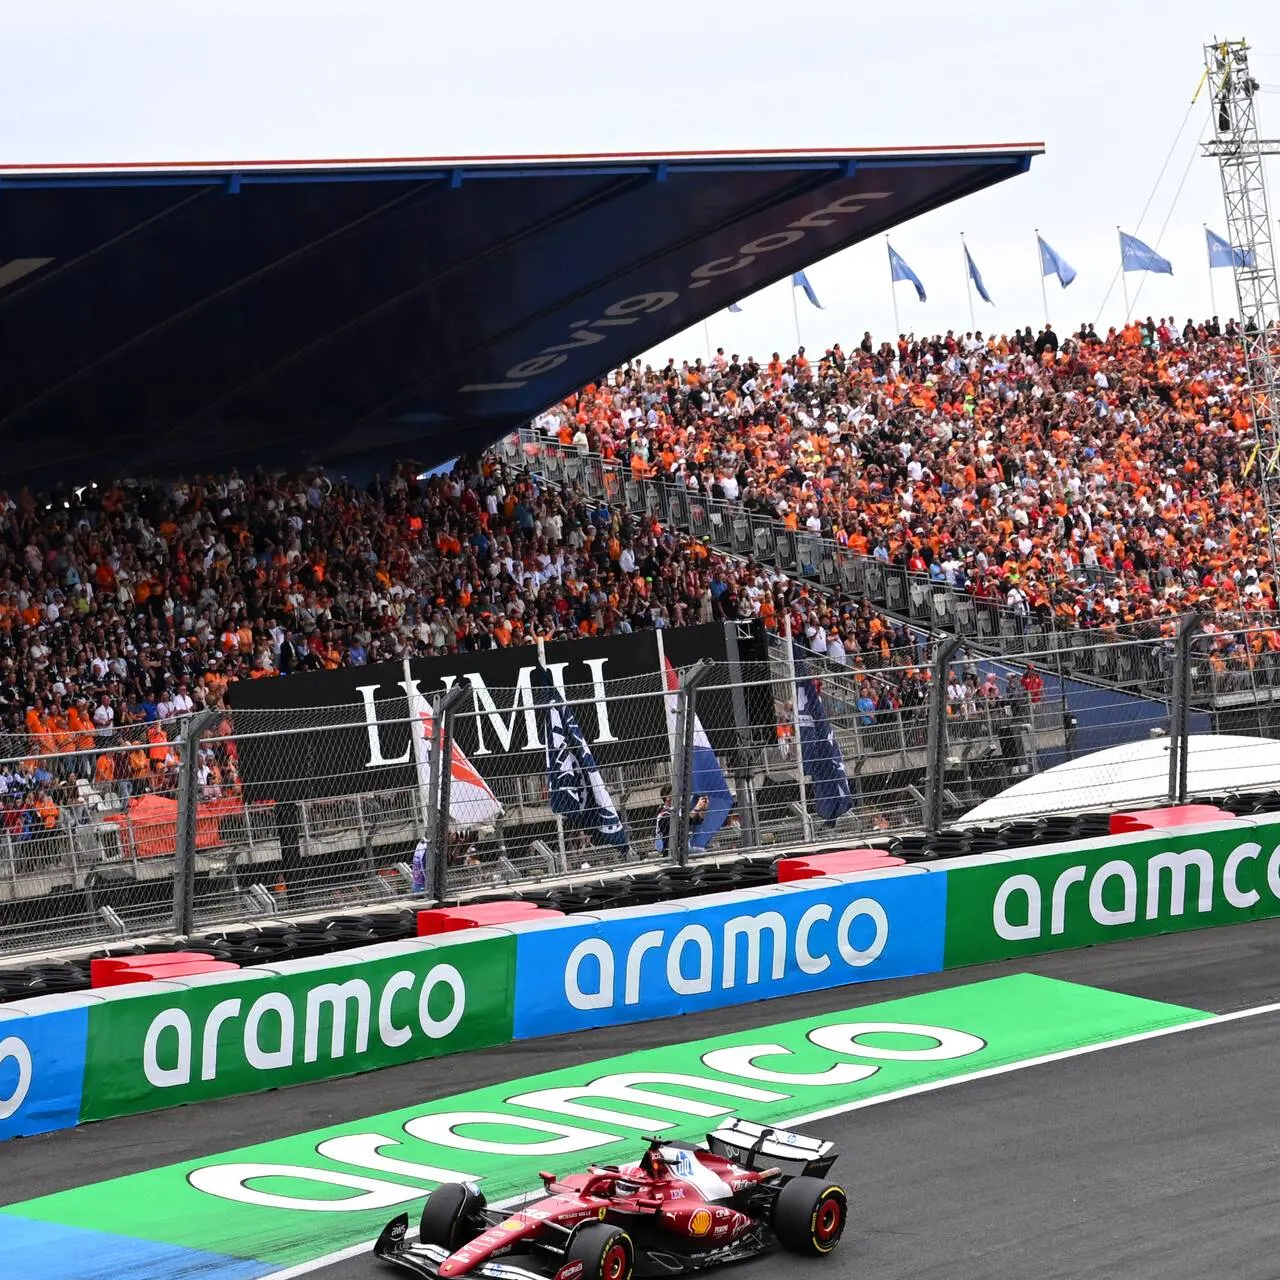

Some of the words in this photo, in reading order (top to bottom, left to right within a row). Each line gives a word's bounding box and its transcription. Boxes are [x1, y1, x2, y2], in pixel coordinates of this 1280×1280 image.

[459, 191, 894, 392] levi9.com
[565, 897, 888, 1011] aramco
[143, 963, 465, 1087] aramco
[188, 1021, 987, 1212] aramco
[391, 1224, 406, 1236] aws
[671, 1189, 685, 1199] IBM
